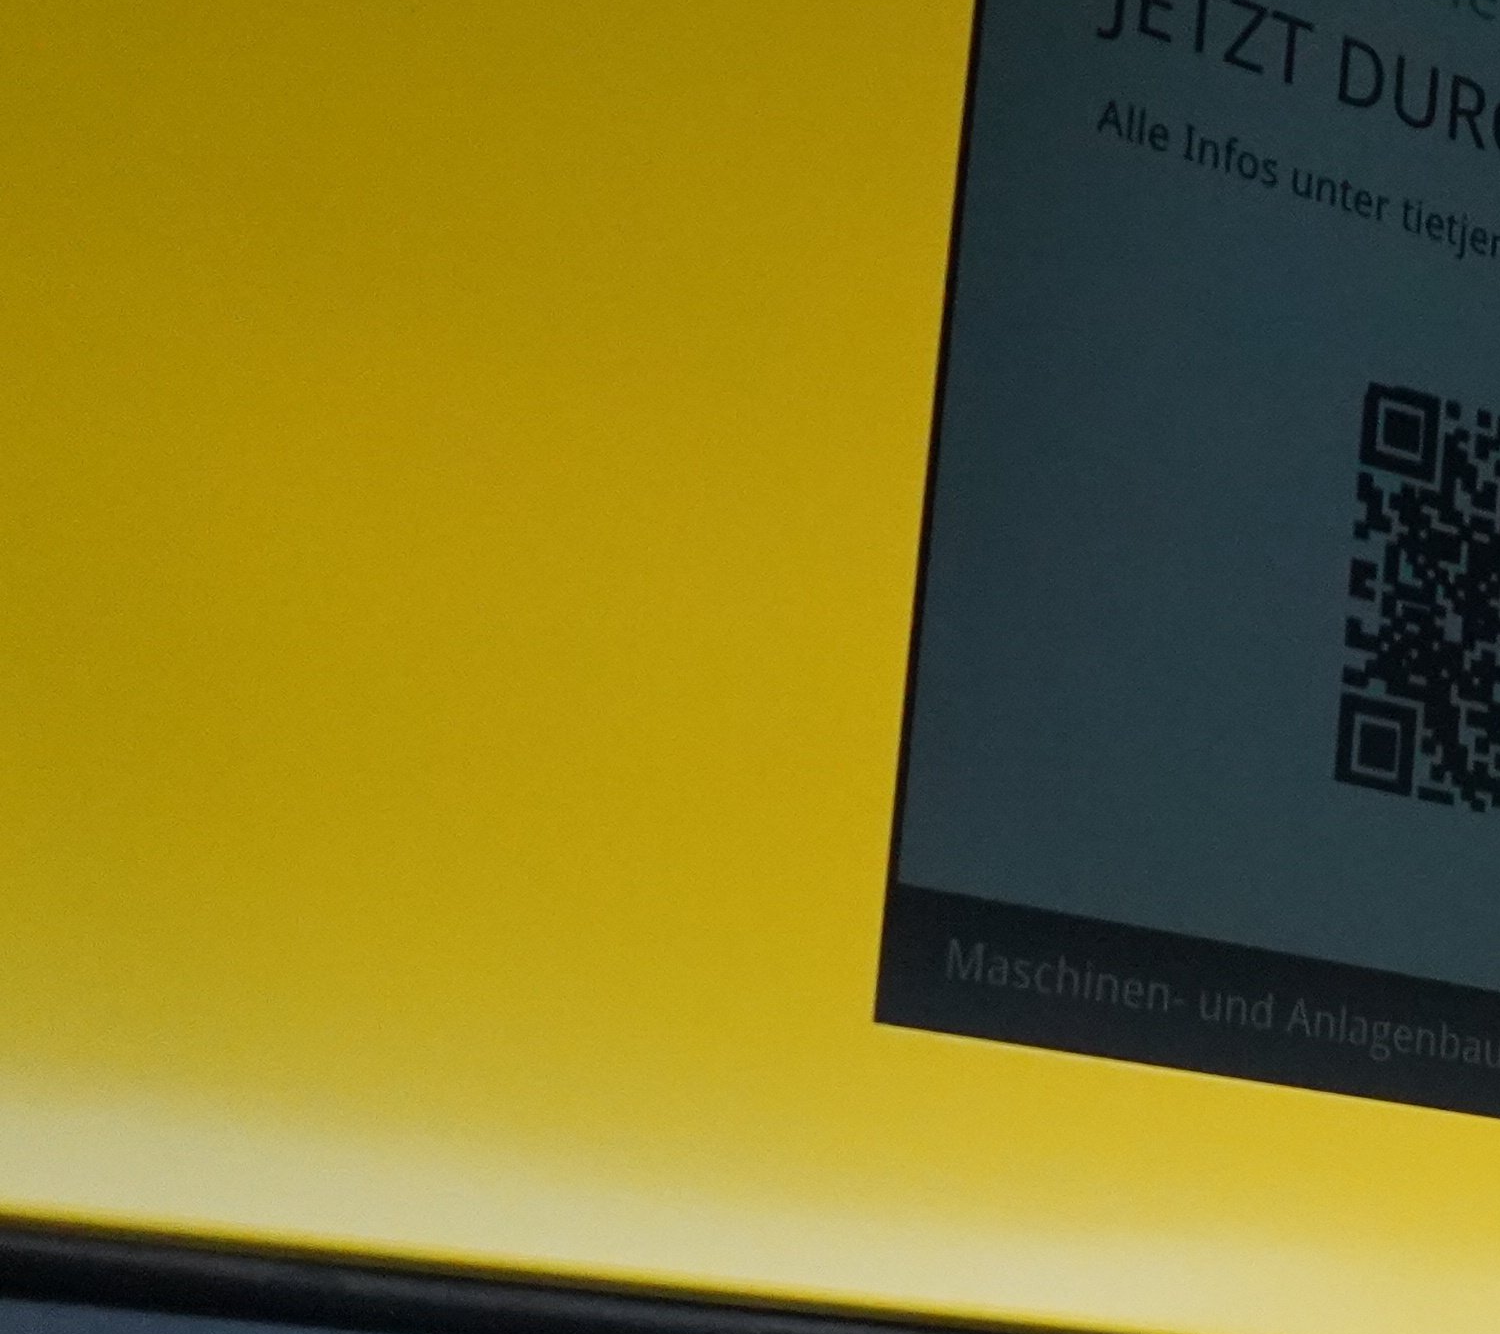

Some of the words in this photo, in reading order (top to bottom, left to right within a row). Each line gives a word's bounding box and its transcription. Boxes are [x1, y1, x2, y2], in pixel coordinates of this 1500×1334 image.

[1097, 98, 1171, 153] Alle
[1183, 121, 1279, 190] Infos
[1290, 164, 1390, 227] unter
[943, 937, 1187, 1016] Maschinen-
[1197, 982, 1274, 1032] und
